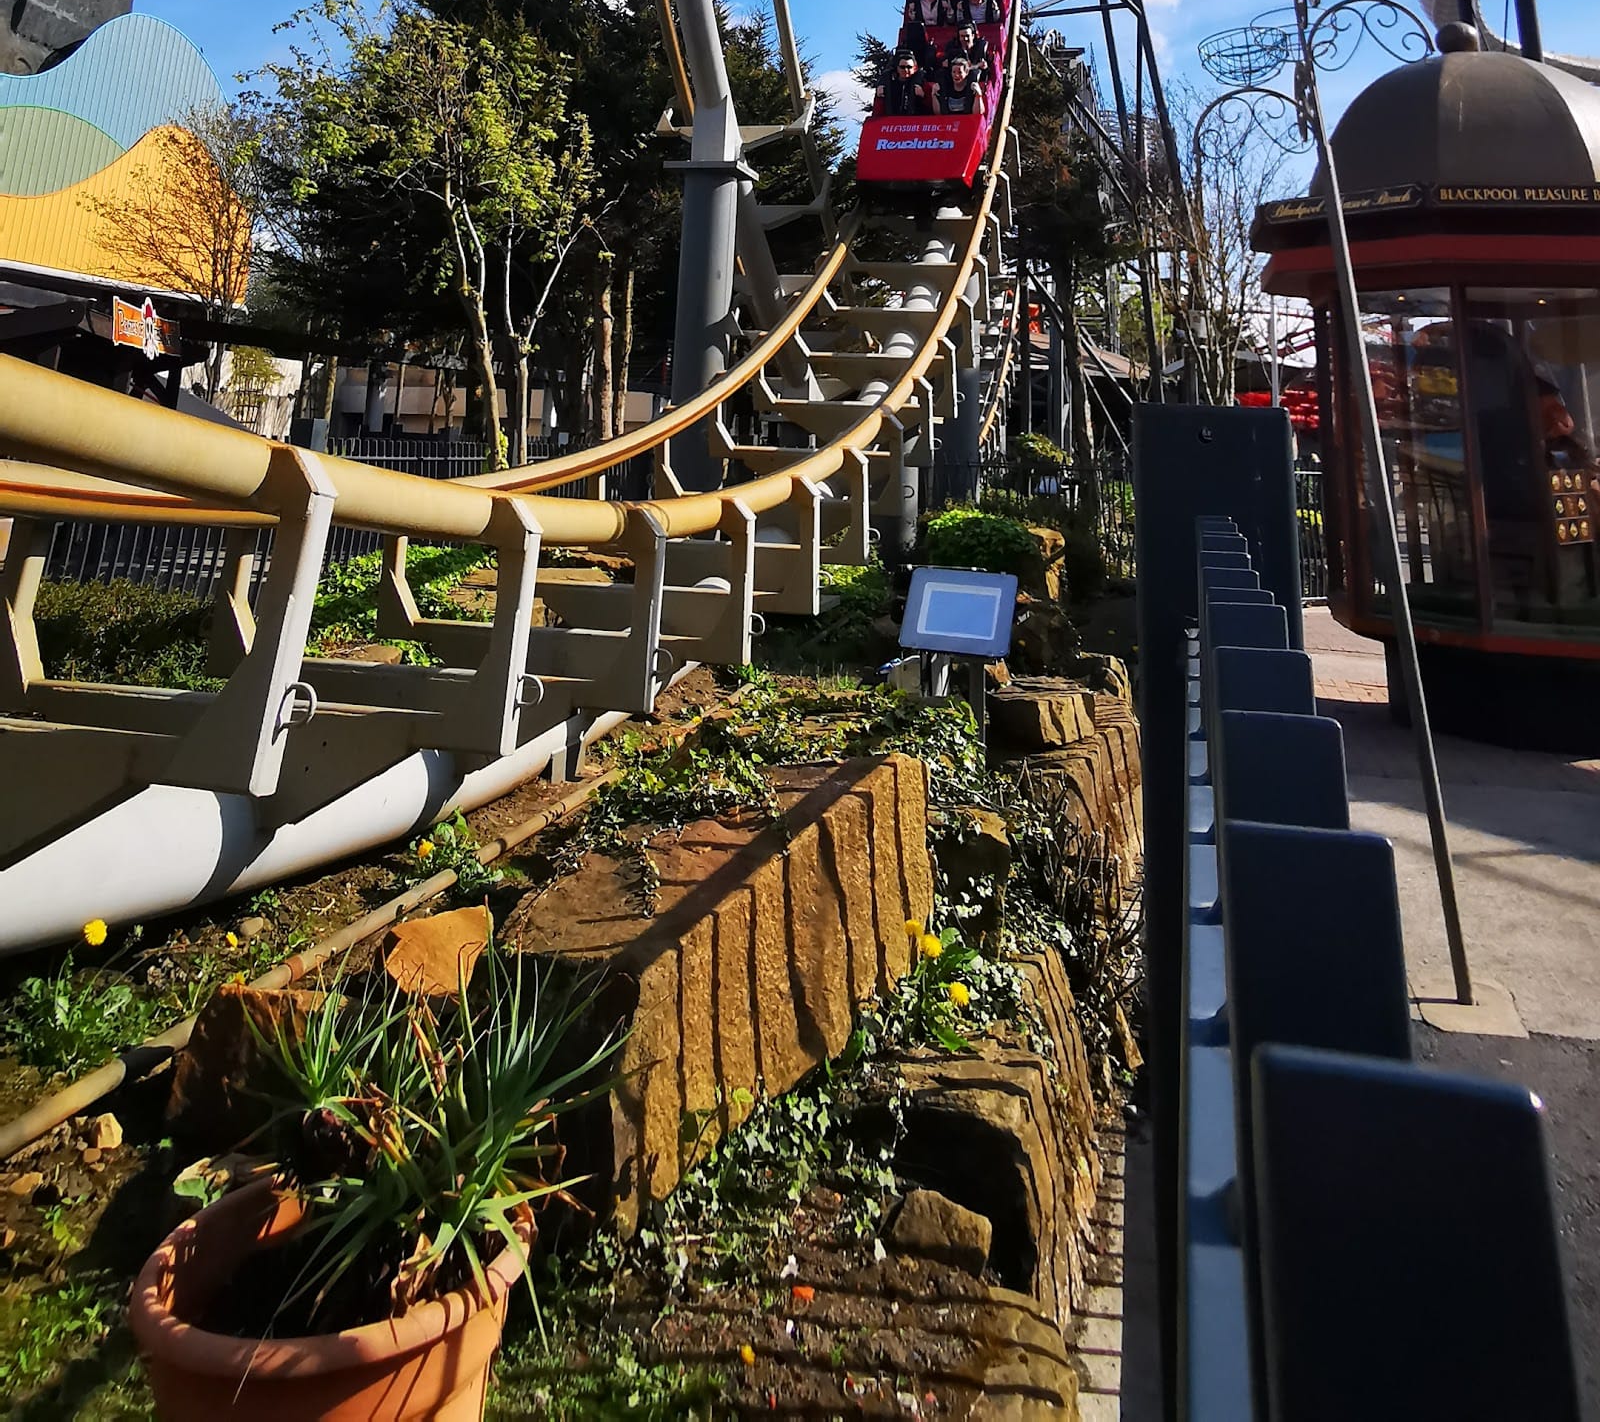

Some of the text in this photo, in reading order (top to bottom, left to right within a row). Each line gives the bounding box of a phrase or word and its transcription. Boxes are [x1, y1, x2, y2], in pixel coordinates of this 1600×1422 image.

[876, 137, 955, 151] Revolution
[1439, 188, 1520, 201] BLACKPOOL
[1524, 188, 1589, 201] PLEASURE
